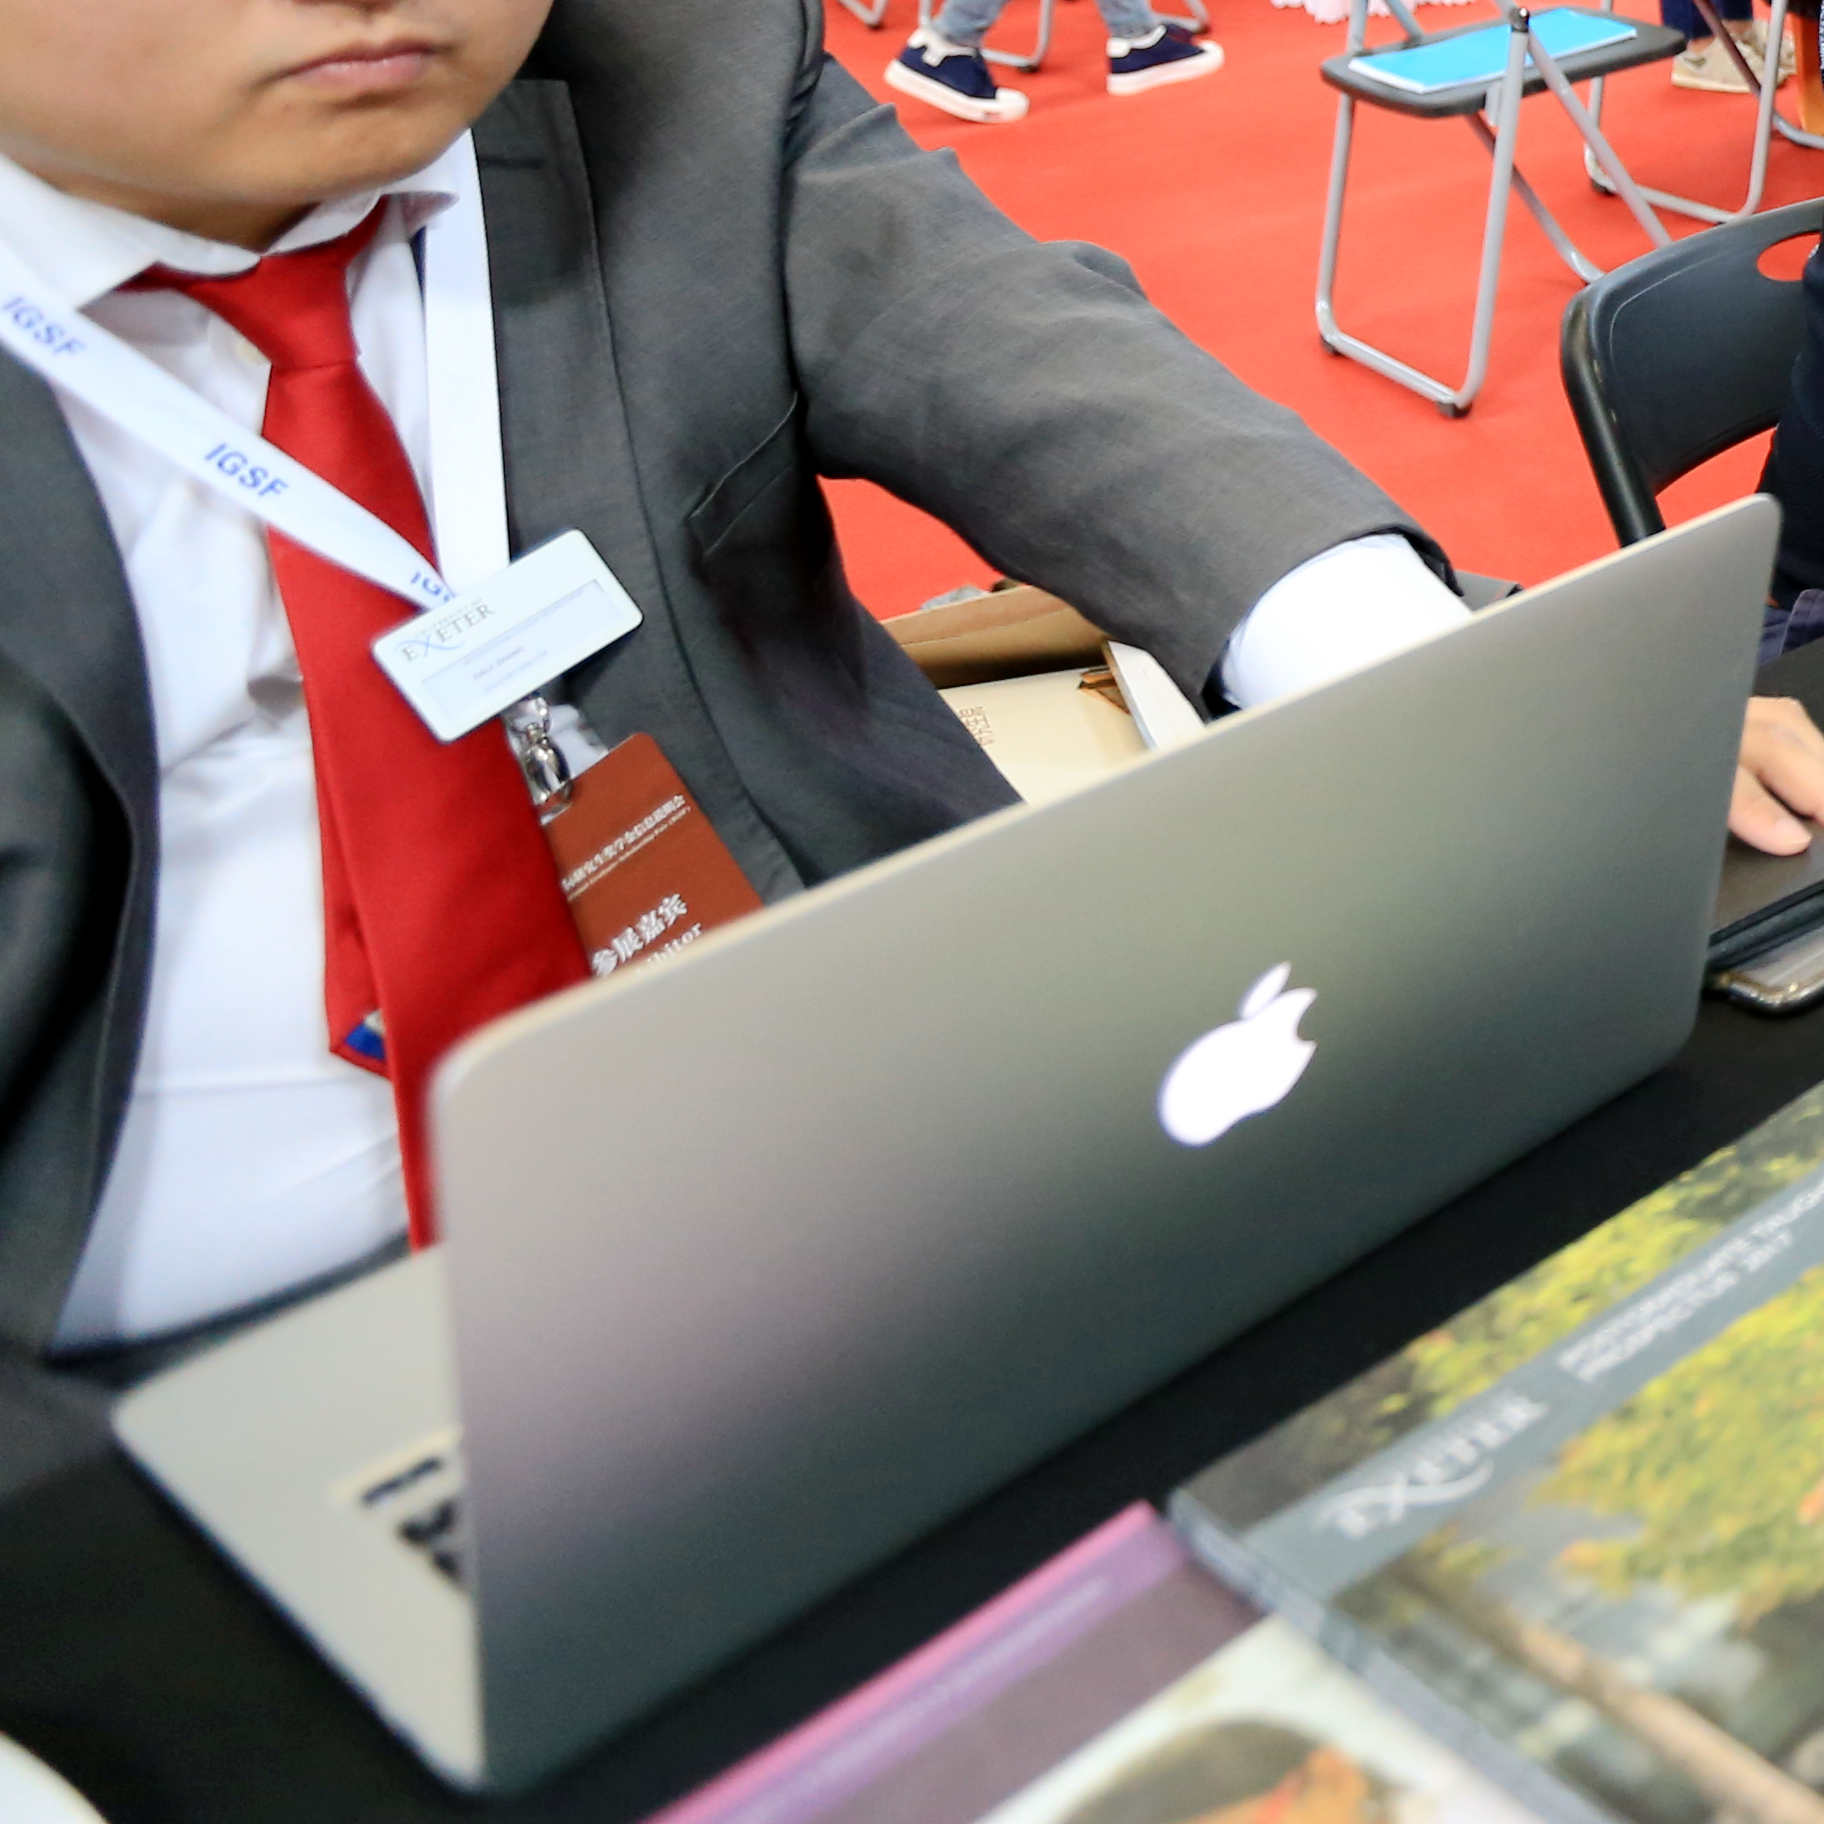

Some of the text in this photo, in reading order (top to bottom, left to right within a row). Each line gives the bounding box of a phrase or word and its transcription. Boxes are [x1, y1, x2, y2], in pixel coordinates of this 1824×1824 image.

[3, 296, 86, 358] IGSF
[204, 443, 290, 500] IGSF
[409, 569, 456, 603] IG
[396, 601, 496, 662] EXETER
